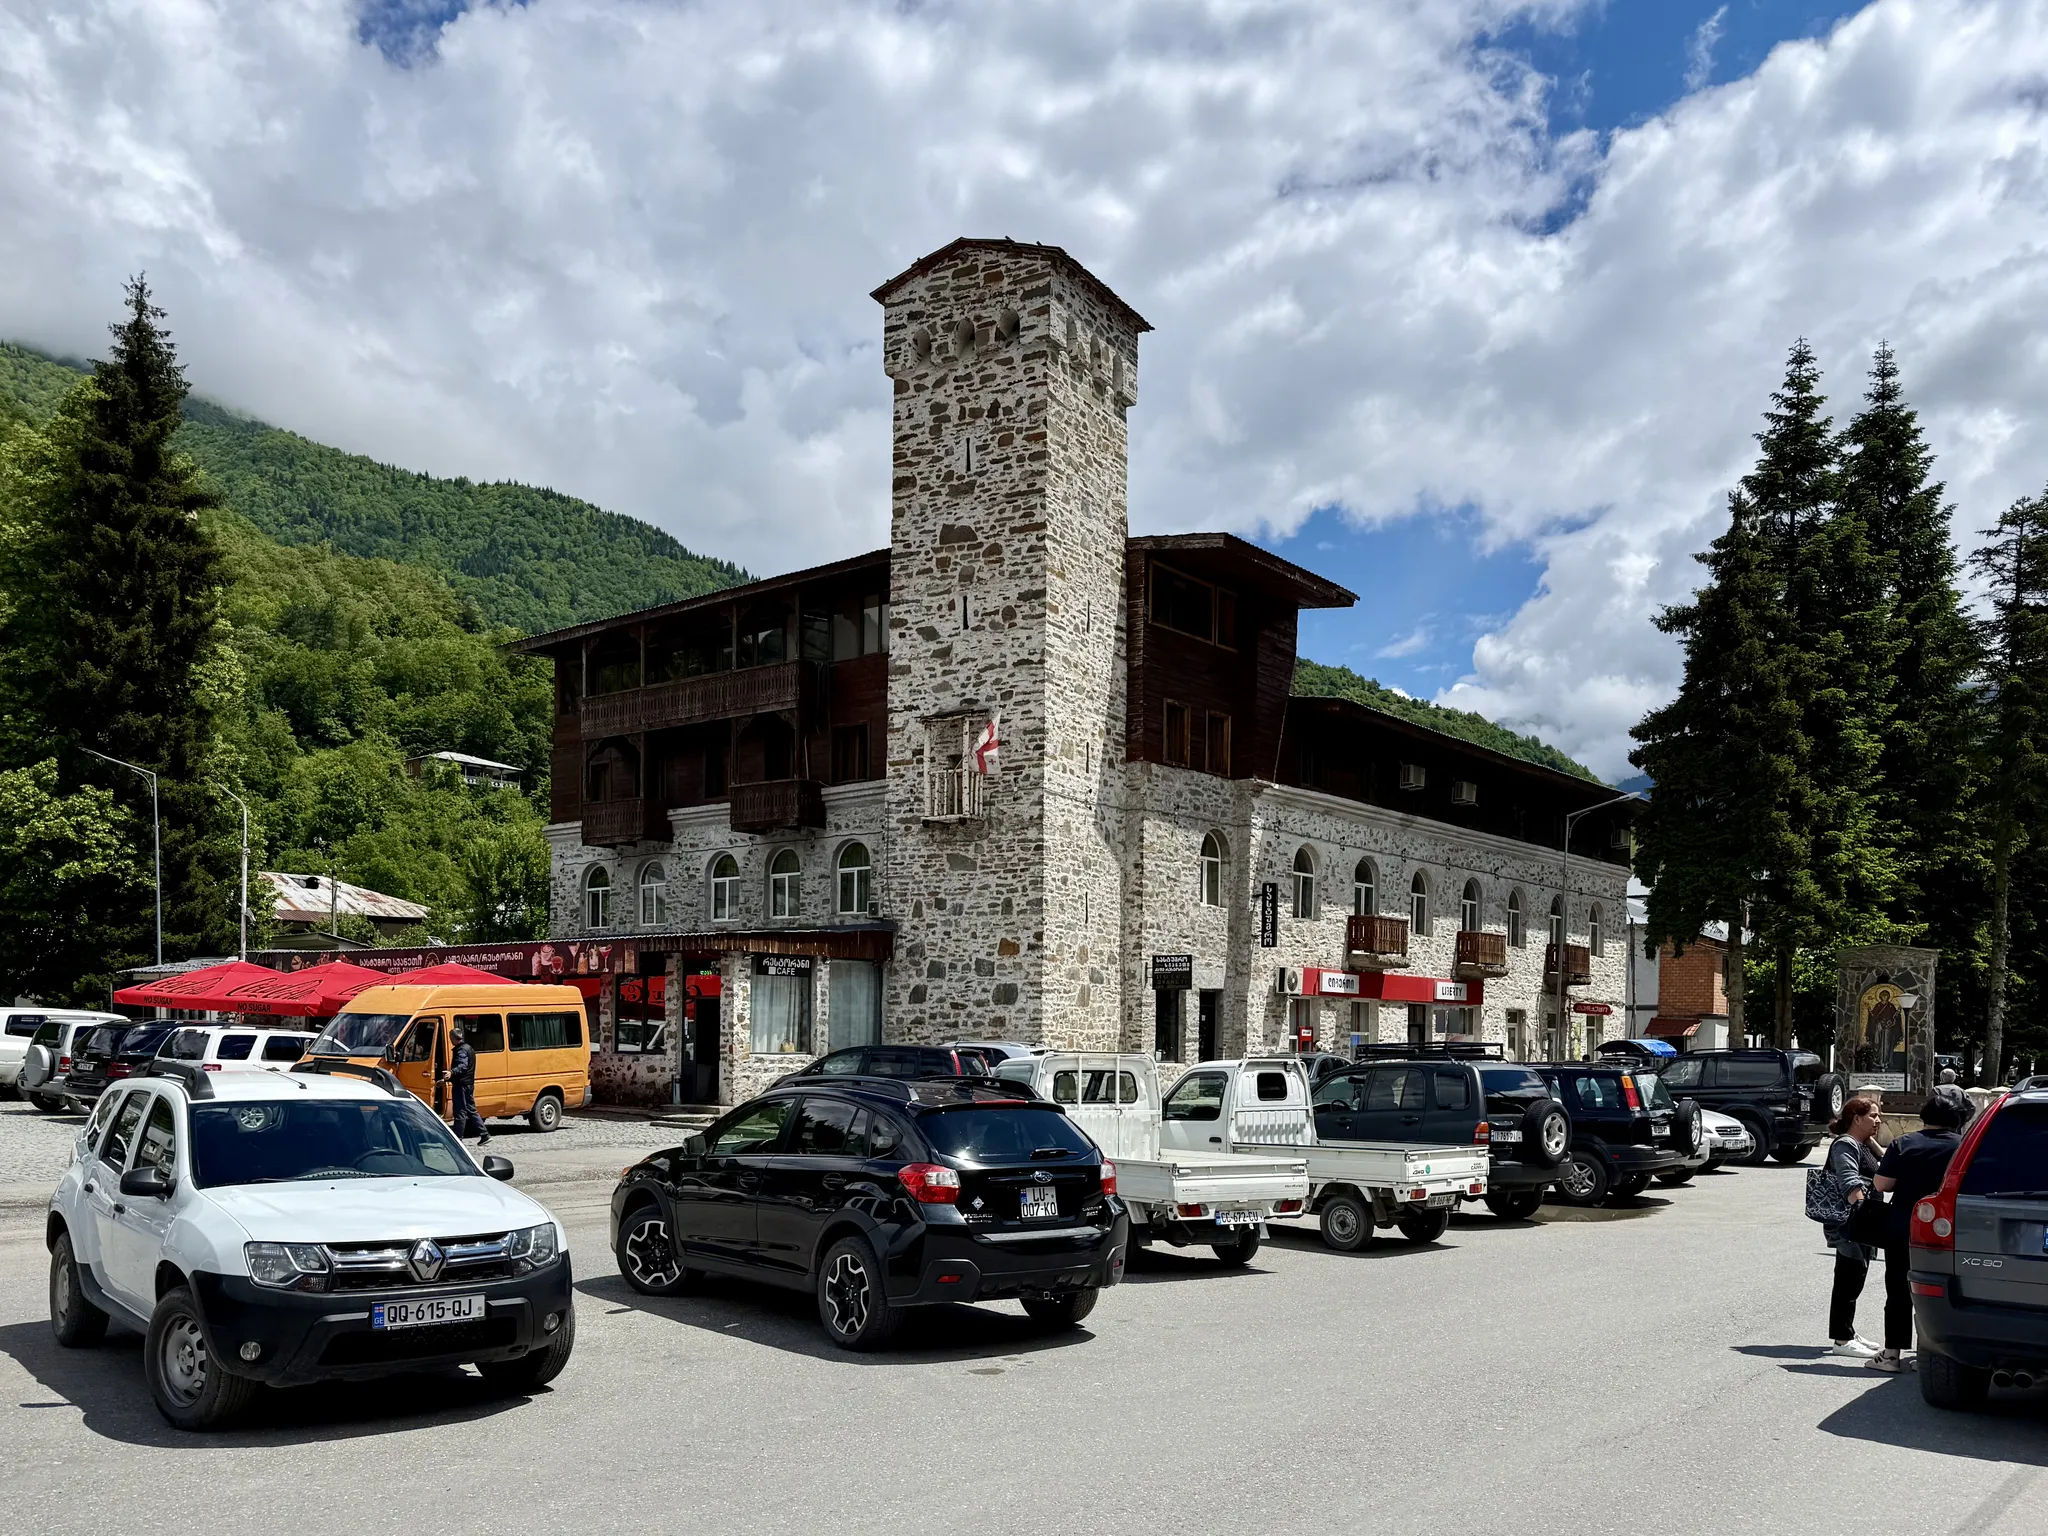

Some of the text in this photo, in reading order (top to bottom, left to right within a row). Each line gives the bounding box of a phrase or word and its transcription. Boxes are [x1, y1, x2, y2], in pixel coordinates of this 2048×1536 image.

[1263, 884, 1273, 946] სასტუმრო
[359, 958, 392, 967] სასტუმრო
[762, 957, 810, 969] რესტორანი
[776, 967, 796, 976] CAFE
[1441, 985, 1463, 997] LIBERTY
[144, 995, 173, 1006] NO SUGAR
[237, 1003, 271, 1012] NO SUGAR
[387, 1298, 473, 1323] QQ-615-QJ
[374, 1316, 384, 1325] GE
